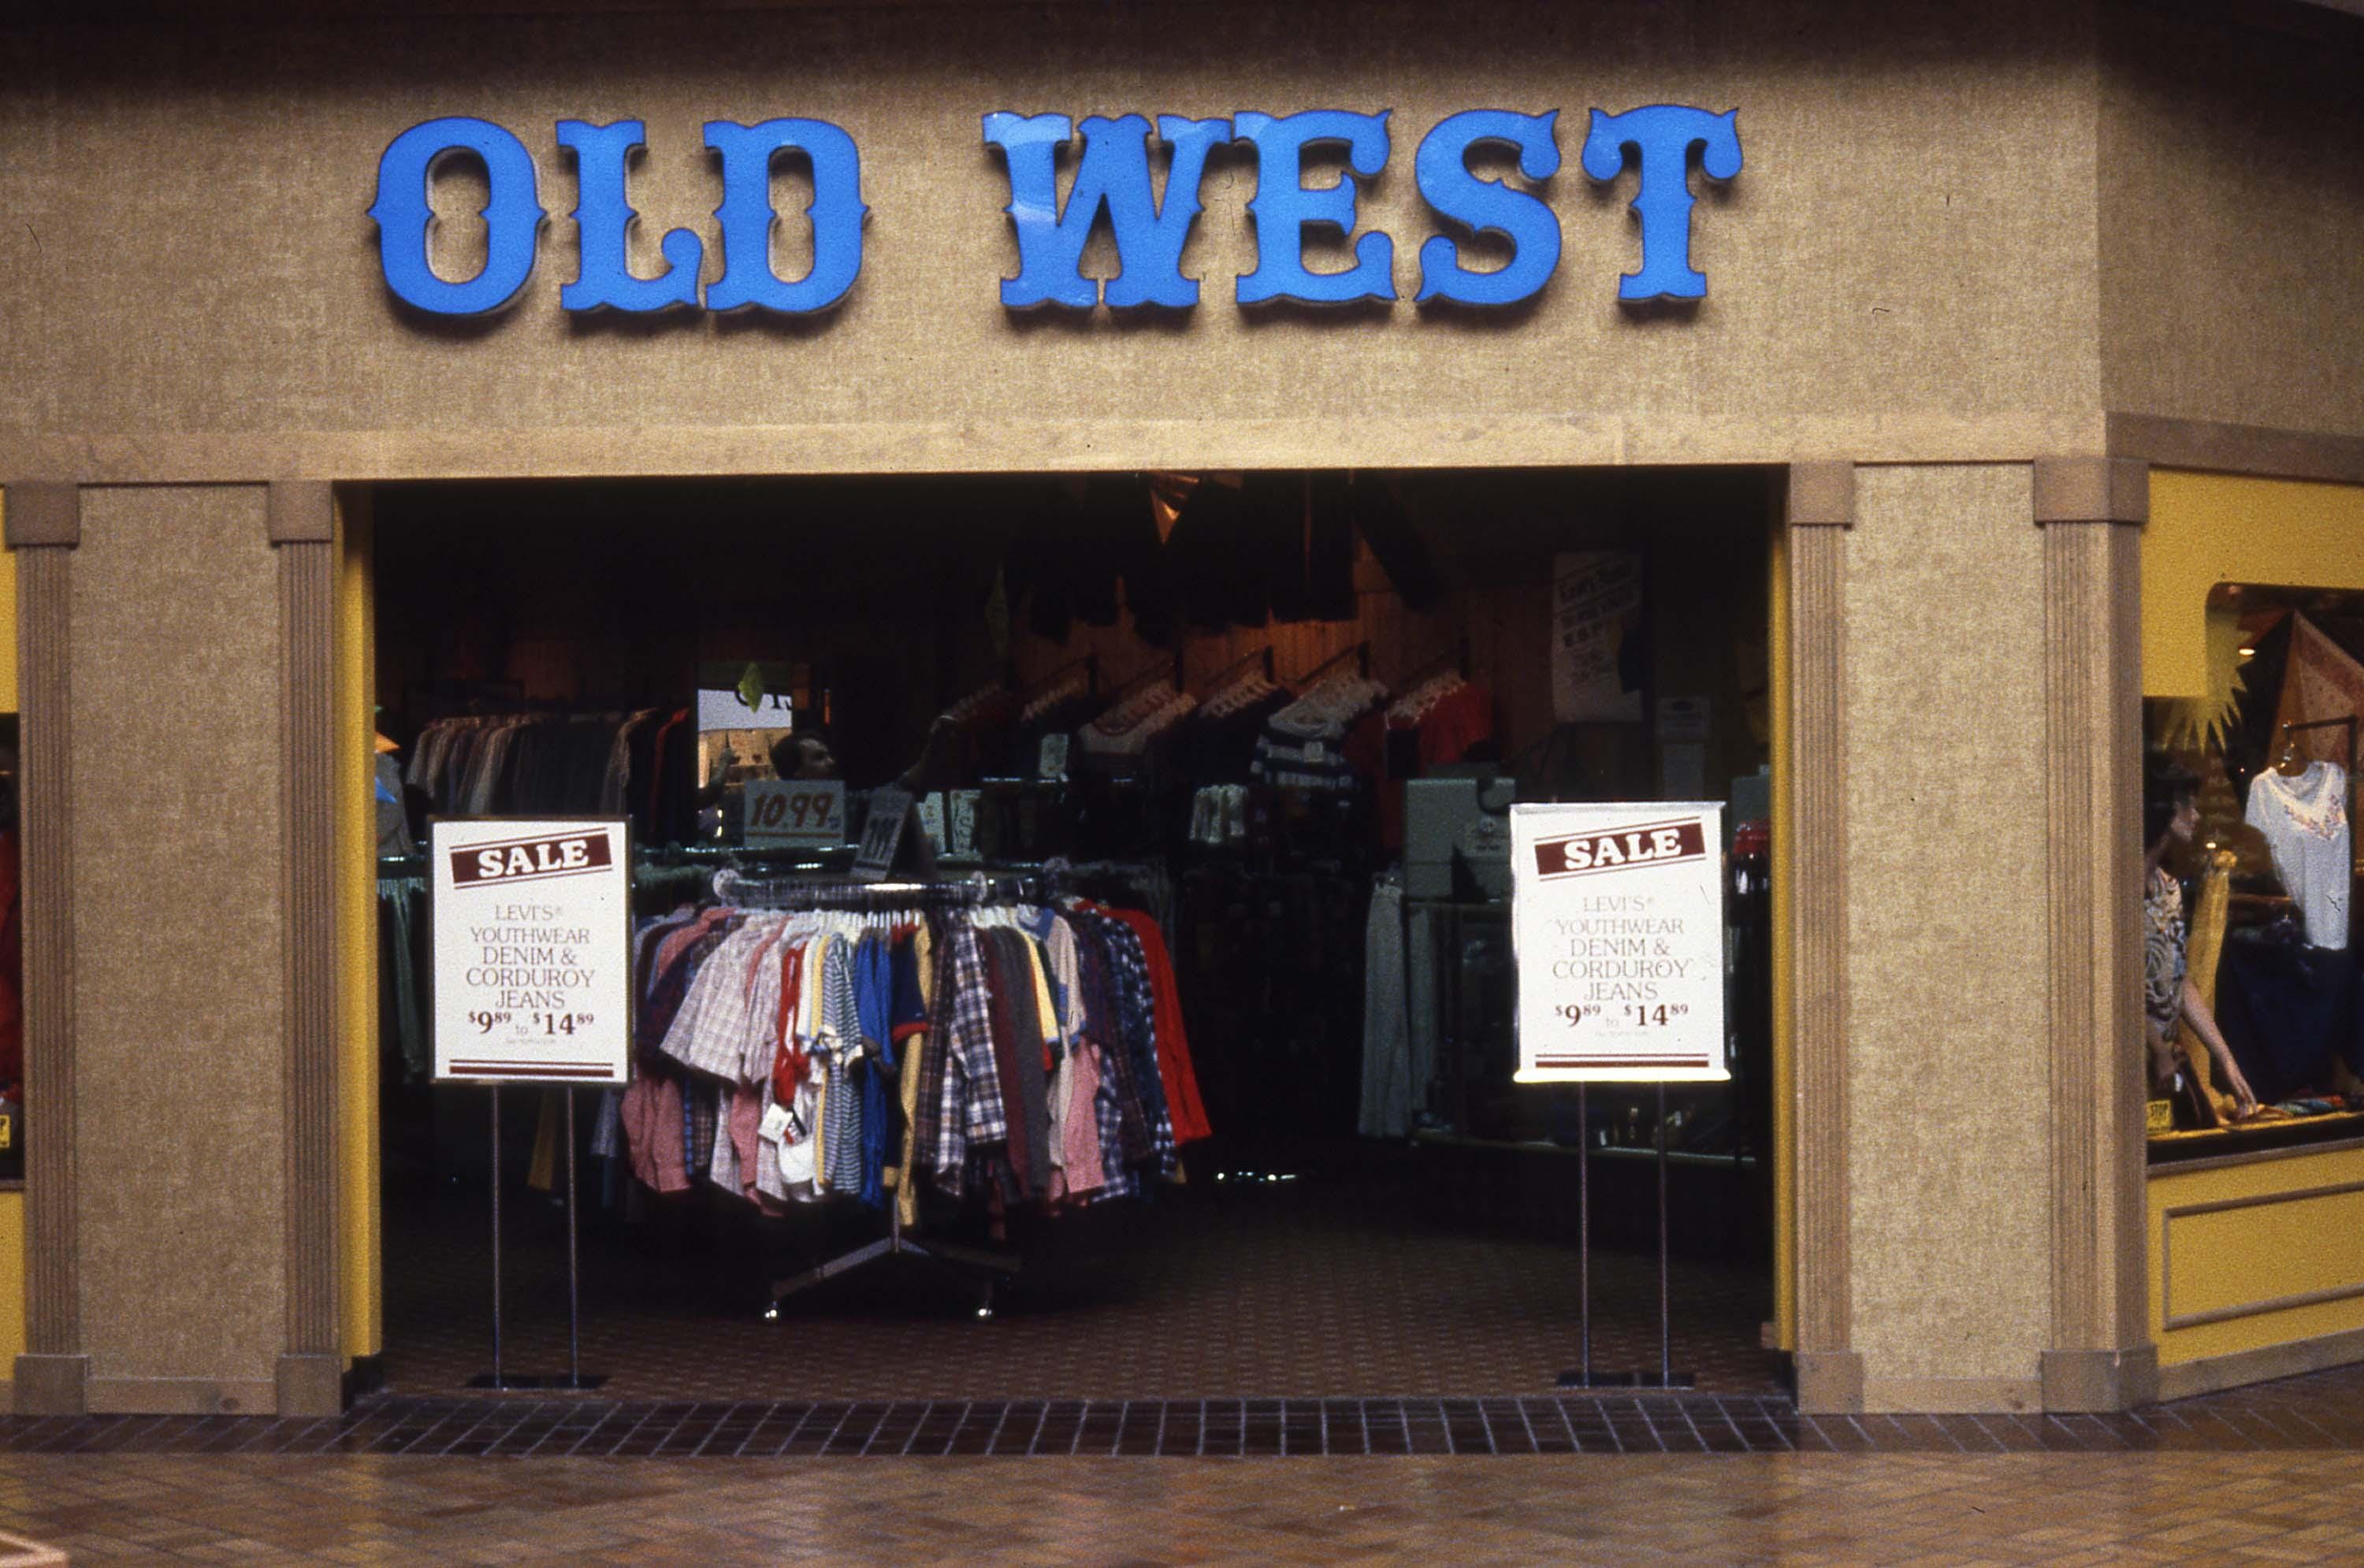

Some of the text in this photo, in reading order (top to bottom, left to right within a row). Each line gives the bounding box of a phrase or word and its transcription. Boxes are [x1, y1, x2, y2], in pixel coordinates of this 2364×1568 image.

[365, 104, 1743, 315] OLD WEST
[478, 838, 589, 879] SALE
[1563, 827, 1683, 871] SALE
[470, 927, 590, 944] YOUTHWEAR
[1555, 918, 1684, 935] YOUTHWEAR
[483, 947, 578, 966] DENIM &
[1570, 938, 1671, 957] DENIM &
[466, 968, 595, 989] CORDUROY
[1552, 959, 1691, 980] CORDUROY
[495, 990, 565, 1009] JEANS
[1583, 982, 1659, 1001] JEANS
[515, 1024, 530, 1036] to
[1605, 1015, 1619, 1028] to
